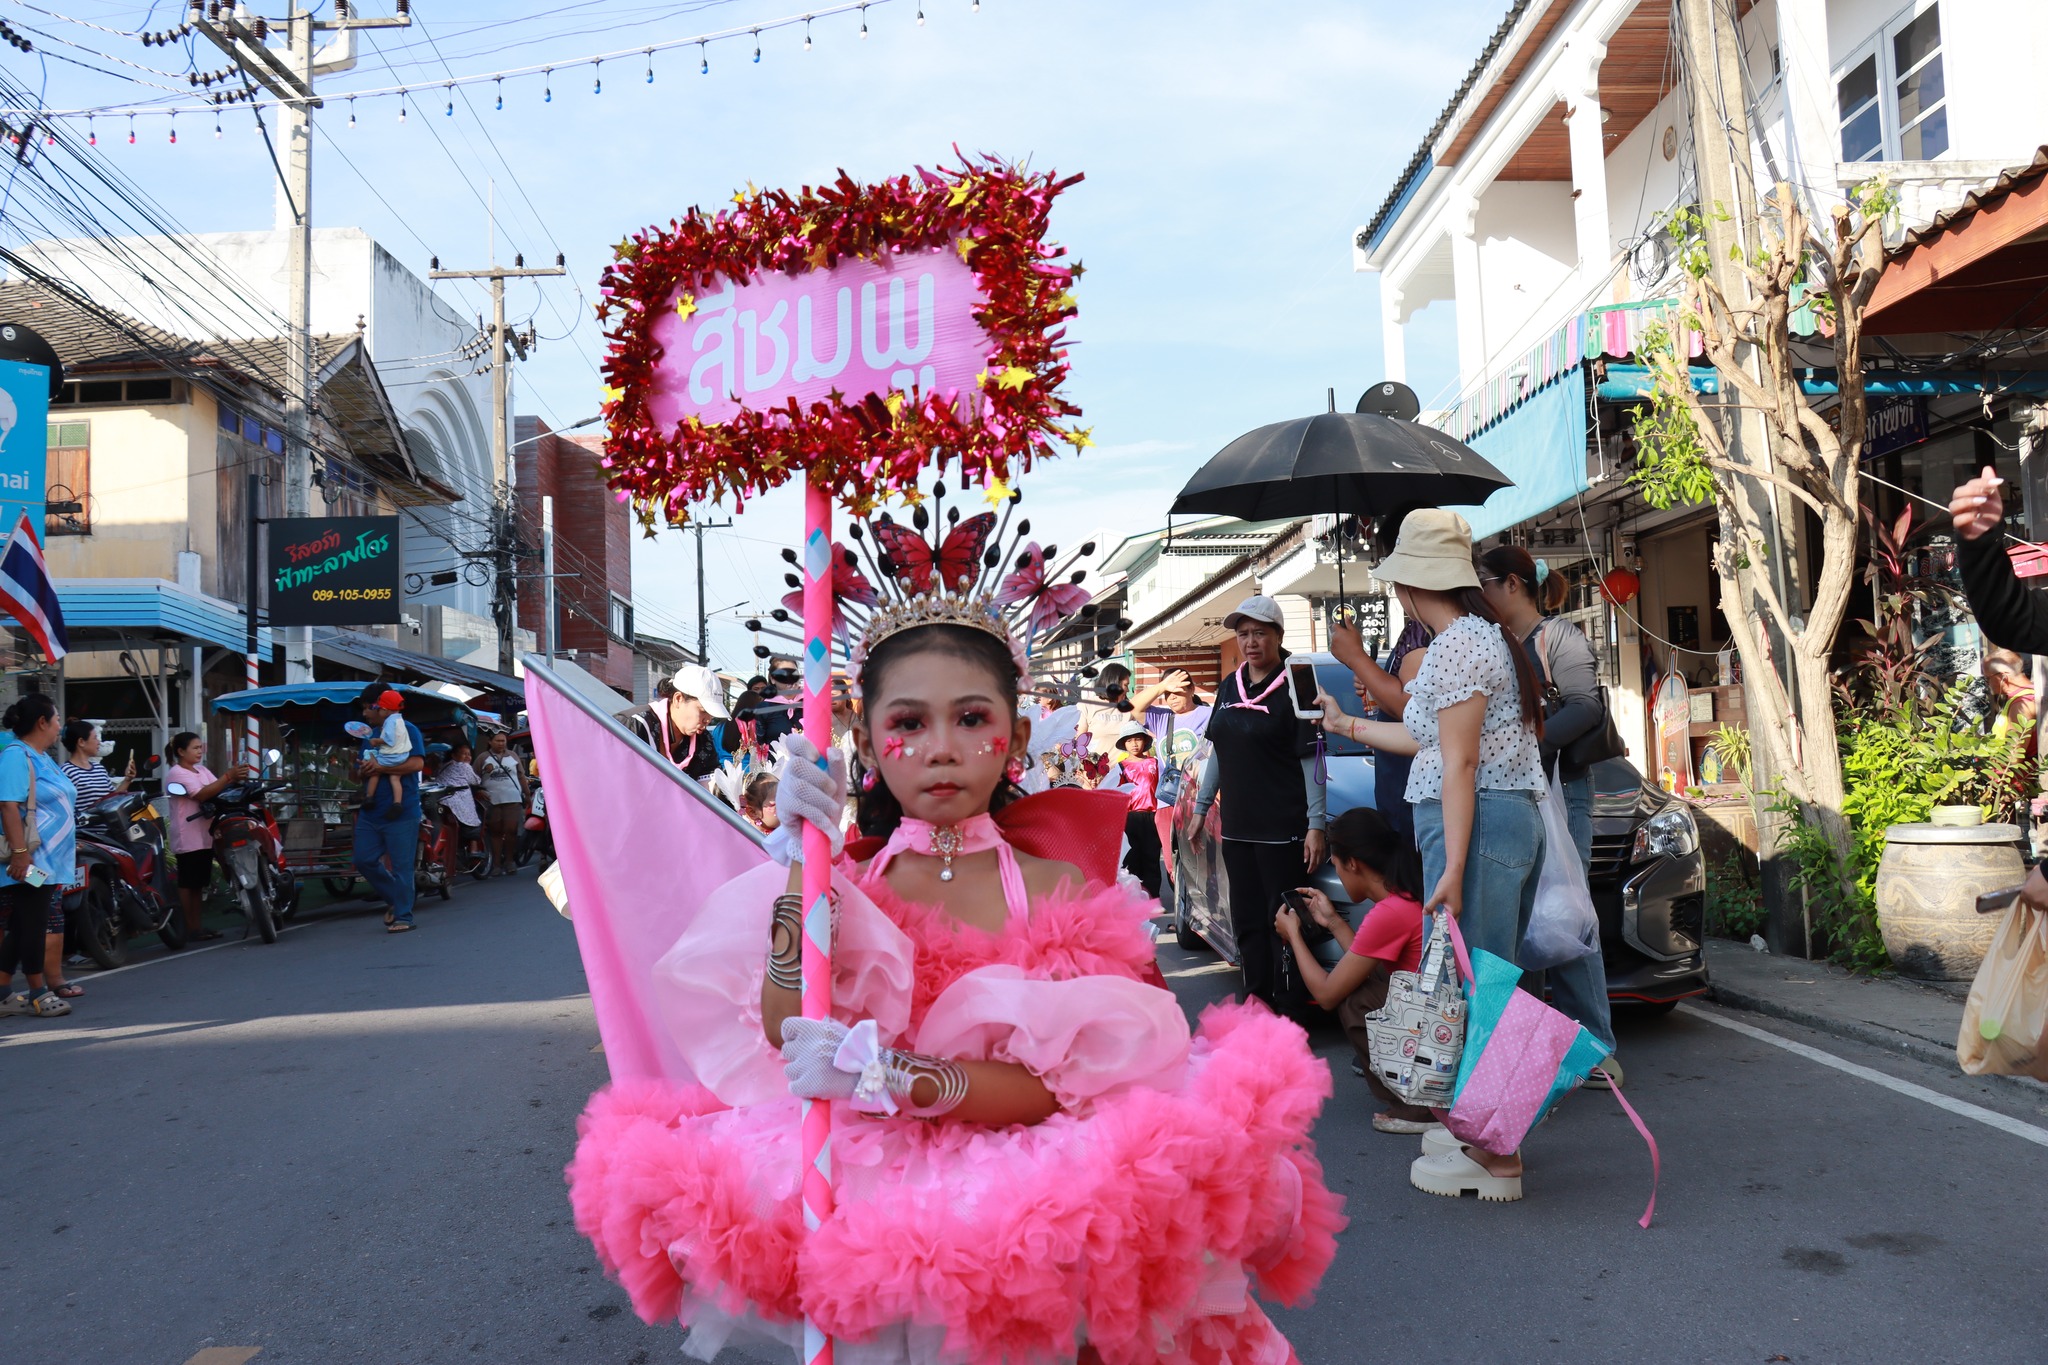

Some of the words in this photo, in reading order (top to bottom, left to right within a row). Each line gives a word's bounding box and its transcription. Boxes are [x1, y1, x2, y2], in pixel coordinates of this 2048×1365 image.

[688, 273, 937, 405] สีชมพู
[284, 528, 341, 563] รีสอร์ท
[312, 588, 391, 601] 089-105-0955
[1362, 616, 1385, 627] ต้อง
[1362, 627, 1385, 636] ลอง
